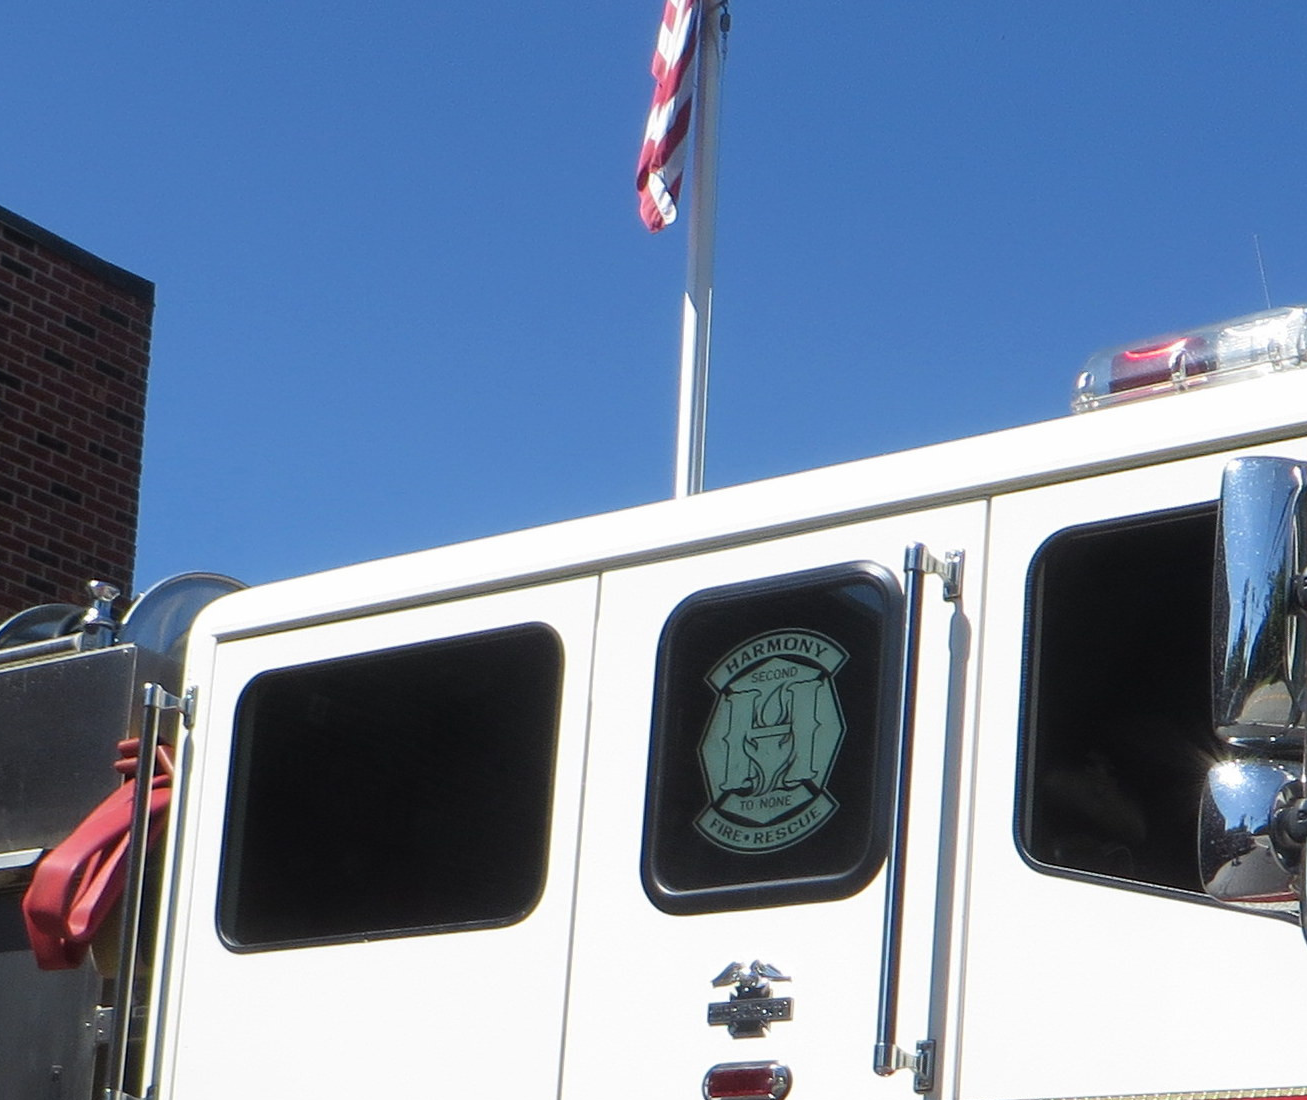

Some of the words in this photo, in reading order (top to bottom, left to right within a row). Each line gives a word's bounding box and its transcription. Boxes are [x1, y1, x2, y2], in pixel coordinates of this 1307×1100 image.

[726, 637, 828, 675] HARMONY
[751, 666, 799, 684] SECOND
[740, 800, 754, 811] TO
[759, 794, 793, 810] NONE
[708, 818, 743, 843] FIRE
[752, 806, 822, 845] RESCUE
